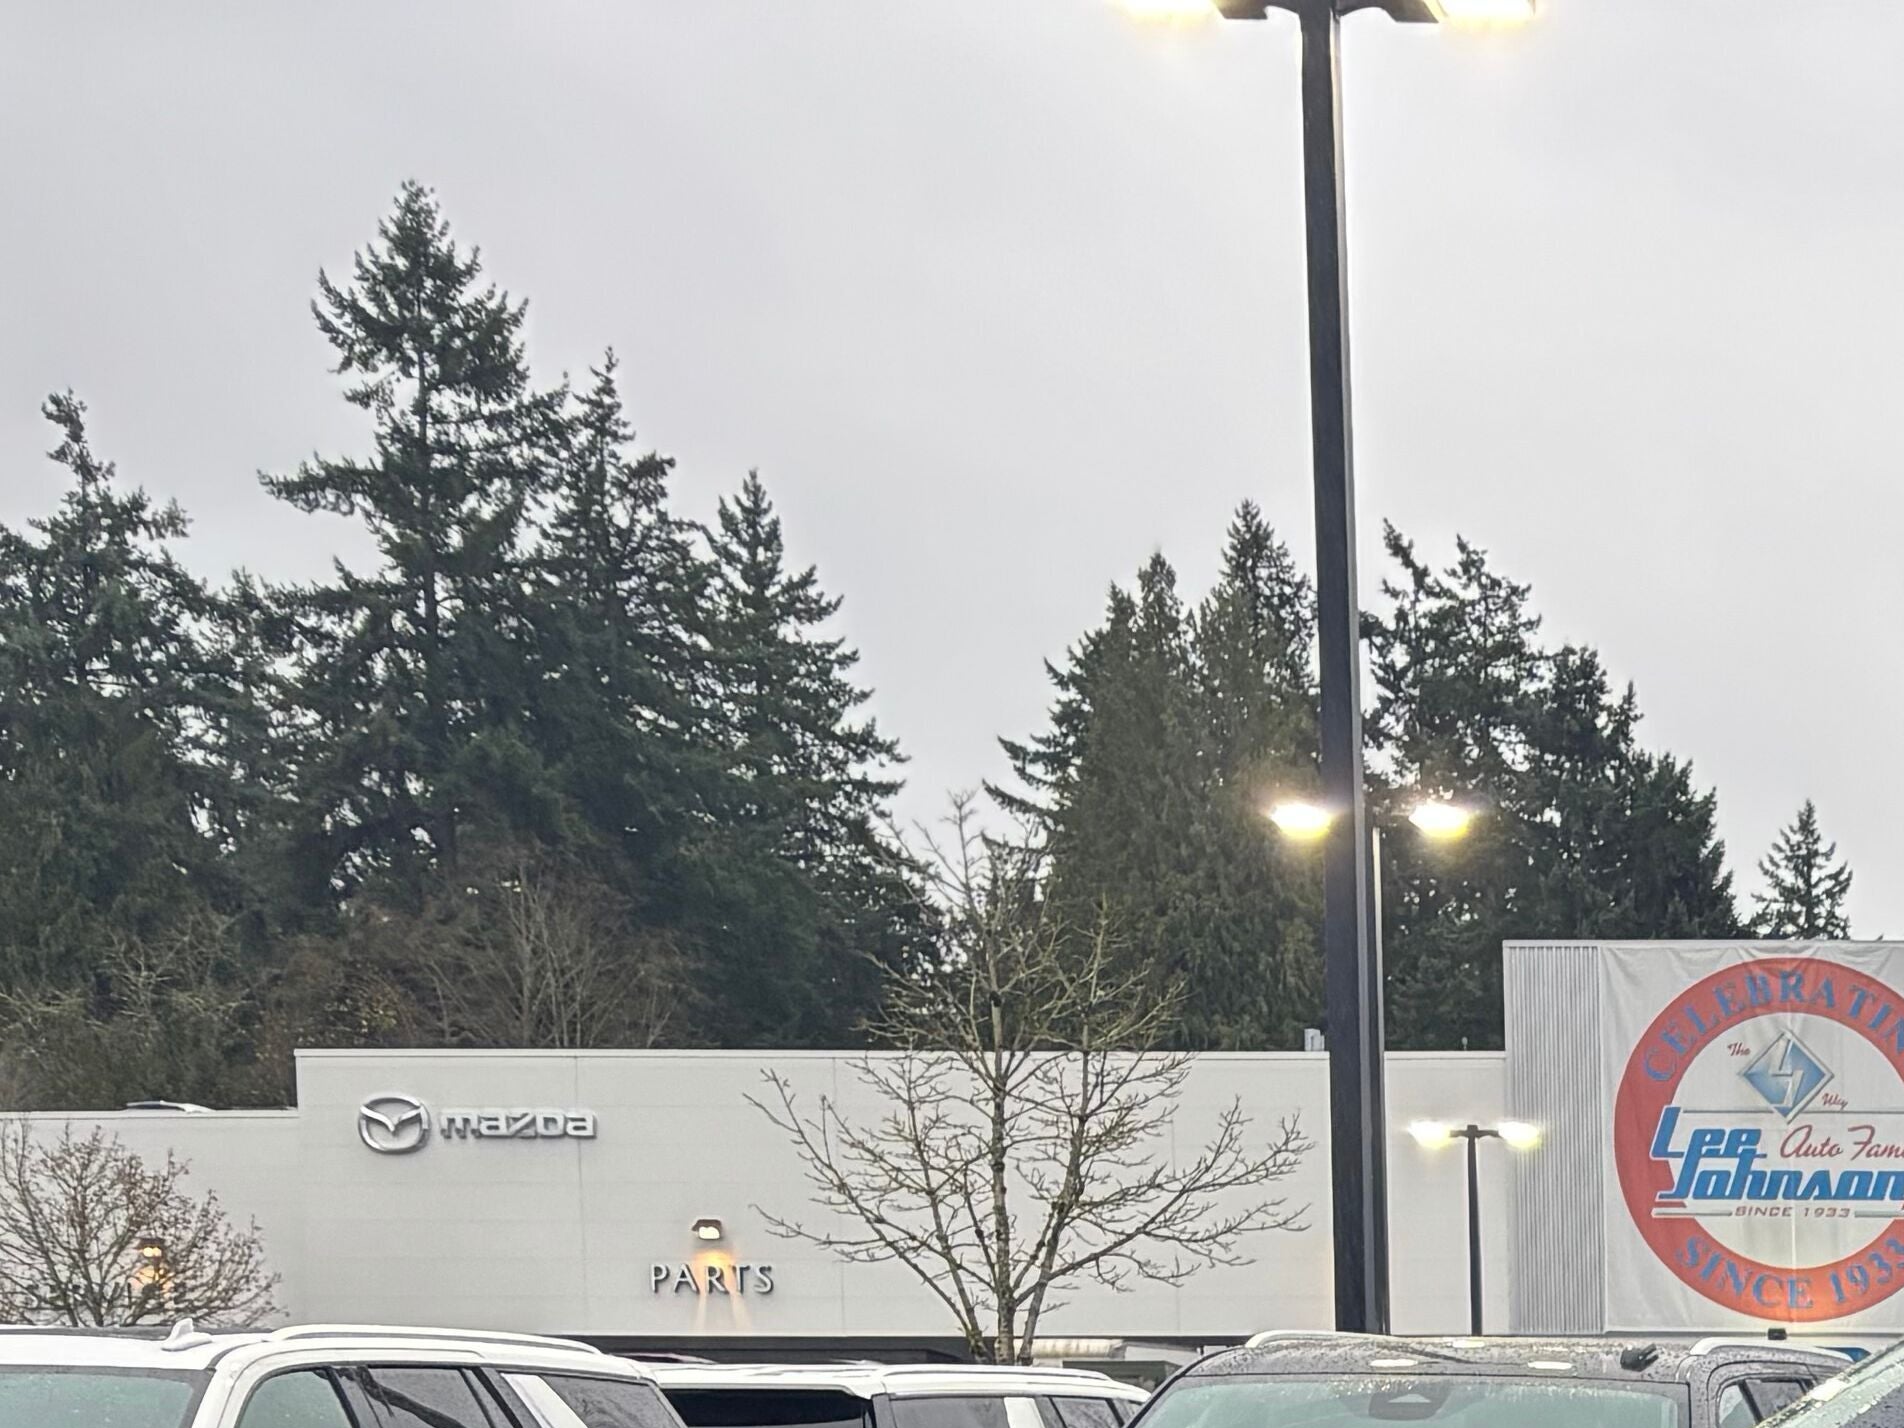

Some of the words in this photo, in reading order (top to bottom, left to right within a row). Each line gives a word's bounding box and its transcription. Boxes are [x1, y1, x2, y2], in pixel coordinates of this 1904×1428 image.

[1651, 1105, 1768, 1159] Lee
[1779, 1124, 1844, 1159] Auto
[1734, 1205, 1794, 1218] SINCE
[1803, 1206, 1851, 1218] 1933
[650, 1262, 775, 1295] PARTS
[1675, 1235, 1814, 1309] SINCE
